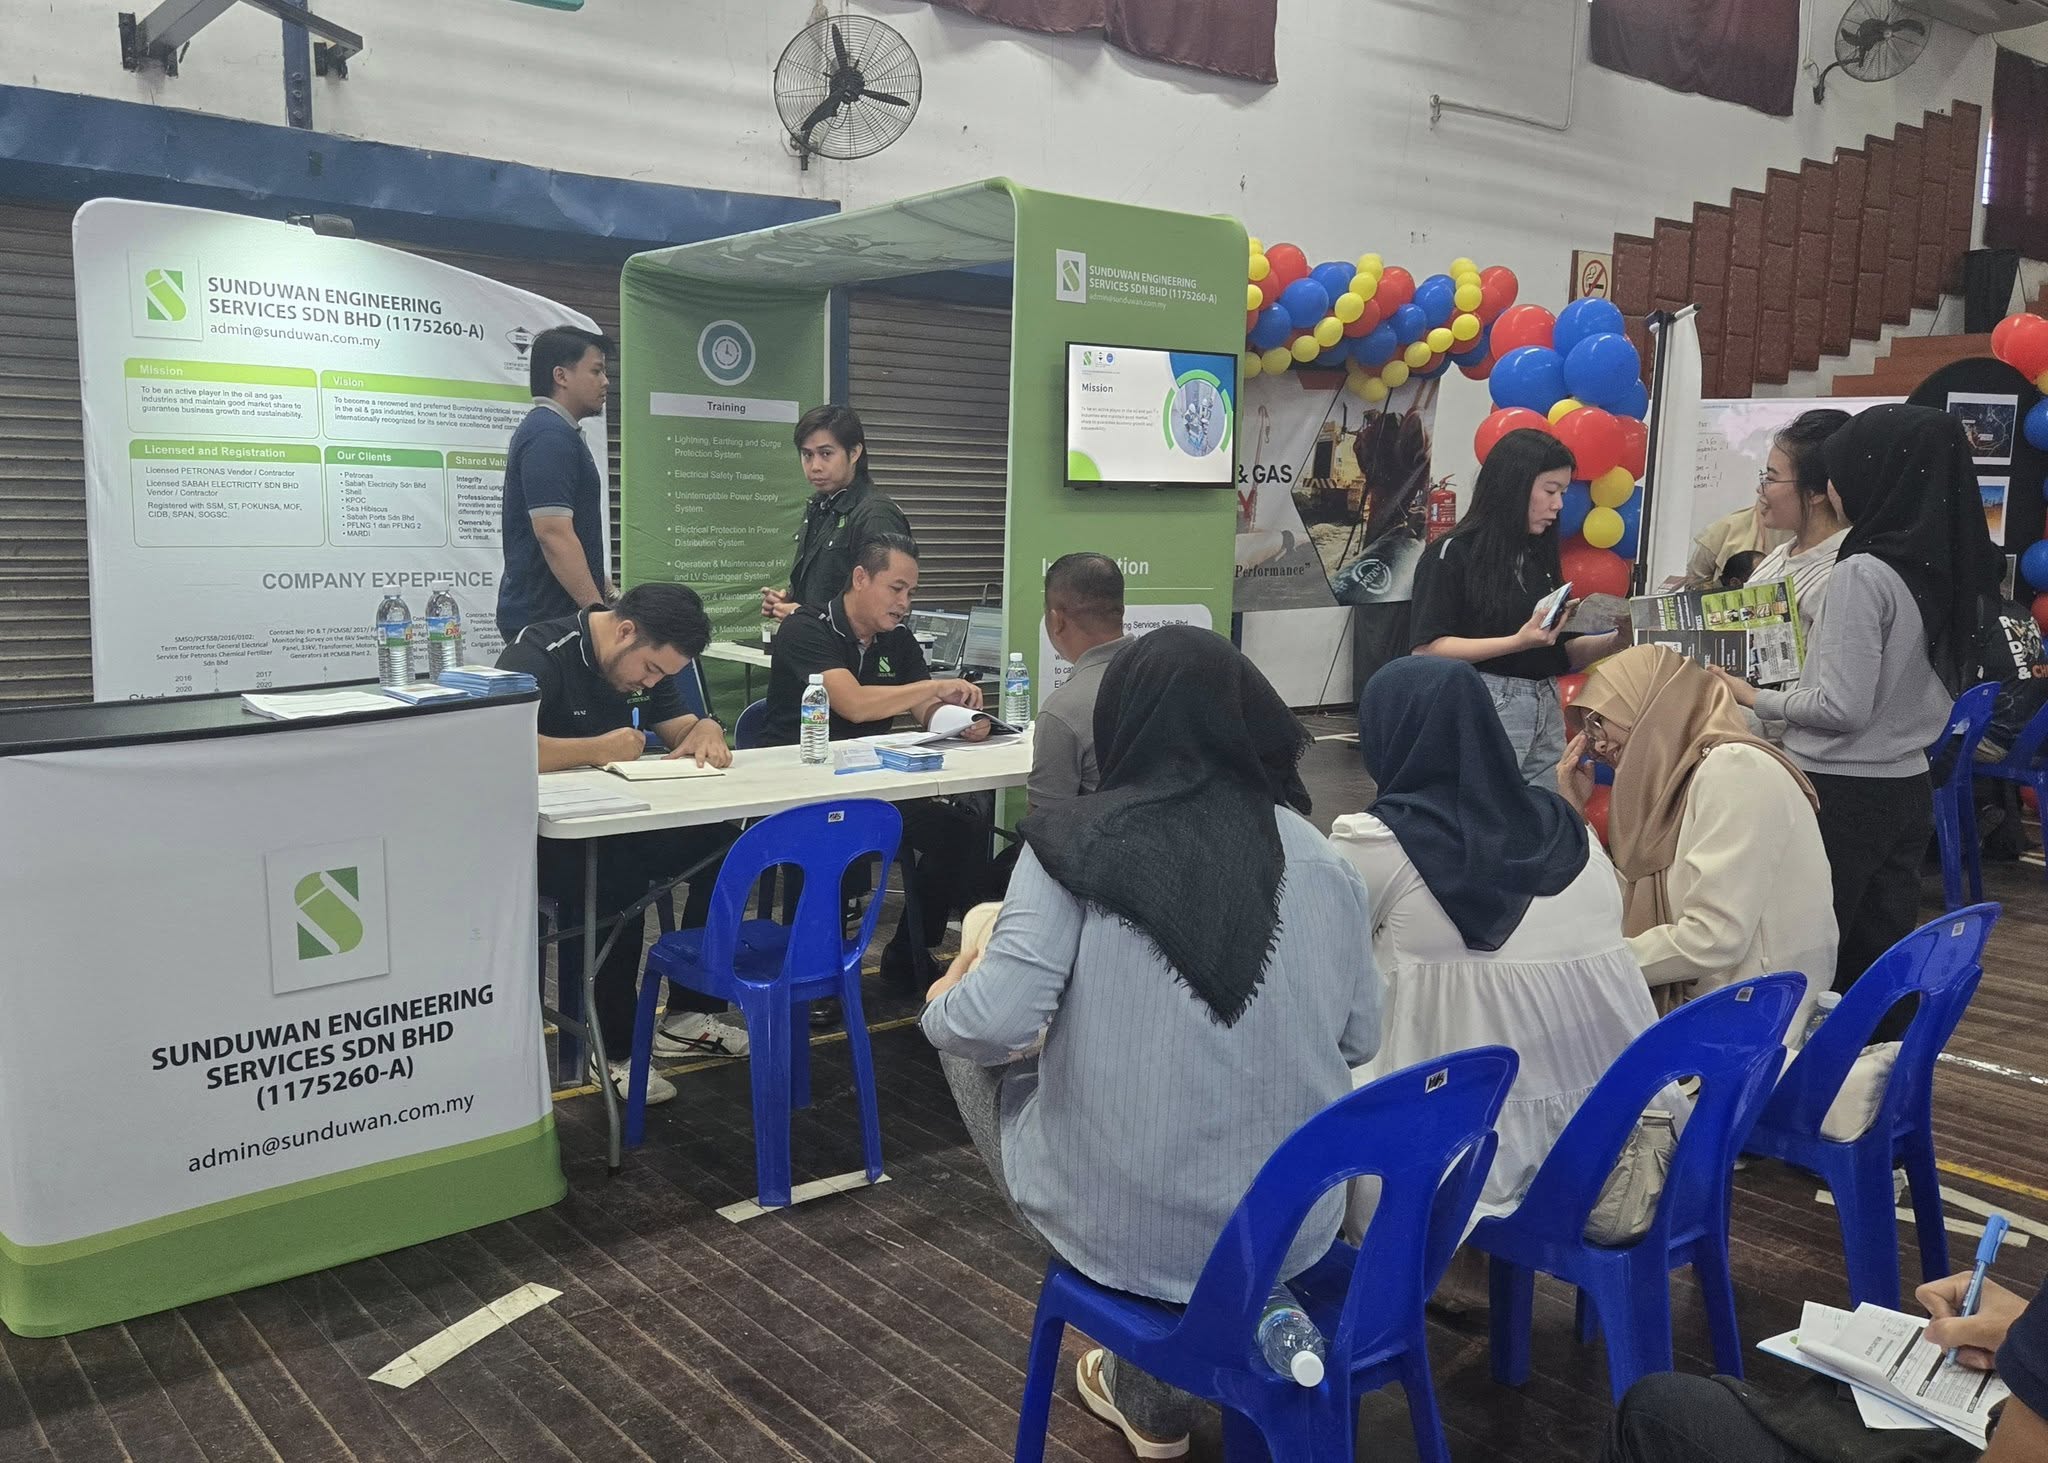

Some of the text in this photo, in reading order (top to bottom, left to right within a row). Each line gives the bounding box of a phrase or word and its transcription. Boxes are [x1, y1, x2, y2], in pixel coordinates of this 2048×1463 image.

[1089, 265, 1197, 289] SUNDUWAN ENGINEERING
[208, 277, 442, 315] SUNDUWAN ENGINEERING
[1089, 278, 1217, 305] SERVICES SDN BHD (1175260-A)
[209, 298, 485, 341] SERVICES SDN BHD (1175260-A)
[210, 323, 381, 349] admin@sunduwan.com.my
[140, 364, 183, 376] Mission
[333, 376, 364, 388] Vision
[1081, 383, 1114, 393] Mission
[175, 387, 197, 396] active
[198, 388, 221, 397] player
[254, 391, 268, 399] and
[179, 397, 193, 405] and
[195, 397, 226, 406] maintain
[227, 399, 246, 407] good
[247, 400, 272, 408] market
[273, 401, 293, 409] share
[343, 397, 370, 405] become
[377, 400, 408, 408] renowned
[423, 402, 451, 411] preferred
[452, 404, 483, 414] Bumiputra
[484, 406, 510, 415] electrical
[707, 400, 746, 415] Training
[142, 405, 180, 414] guarantee
[181, 405, 214, 414] business
[215, 407, 240, 417] growth
[713, 437, 744, 447] Earthing
[744, 439, 759, 447] and
[760, 439, 782, 449] Surge
[144, 445, 286, 458] Licensed and Registration
[337, 451, 392, 462] Our Clients
[675, 449, 713, 458] Protection
[455, 455, 506, 467] Shared Valu
[181, 467, 225, 475] PETRONAS
[227, 468, 252, 476] Vendor
[259, 469, 295, 477] Contractor
[674, 470, 709, 479] Electrical
[710, 471, 734, 481] Safety
[1252, 464, 1293, 484] GAS
[146, 480, 299, 490] Licensed SABAH ELECTRICITY SDN BHD
[367, 481, 398, 489] Electricity
[456, 475, 482, 484] Integrity
[180, 489, 218, 497] Contractor
[675, 491, 779, 503] Uninterruptible Power Supply
[147, 502, 188, 511] Registered
[189, 502, 204, 510] with
[206, 502, 226, 510] SSM,
[674, 526, 708, 534] Electrical
[710, 526, 747, 534] Protection
[756, 526, 779, 534] Power
[674, 560, 711, 569] Operation
[720, 560, 766, 568] Maintenance
[263, 571, 493, 589] COMPANY EXPERIENCE
[674, 573, 688, 581] and
[216, 642, 240, 650] General
[241, 641, 269, 649] Electrical
[190, 651, 218, 659] Petronas
[218, 650, 246, 658] Chemical
[2032, 664, 2048, 679] CH
[151, 984, 494, 1070] SUNDUWAN ENGINEERING
[206, 1019, 455, 1090] SERVICES SDN BHD
[256, 1056, 415, 1111] (1175260-A)
[188, 1093, 475, 1172] admin@sunduwan.com.my
